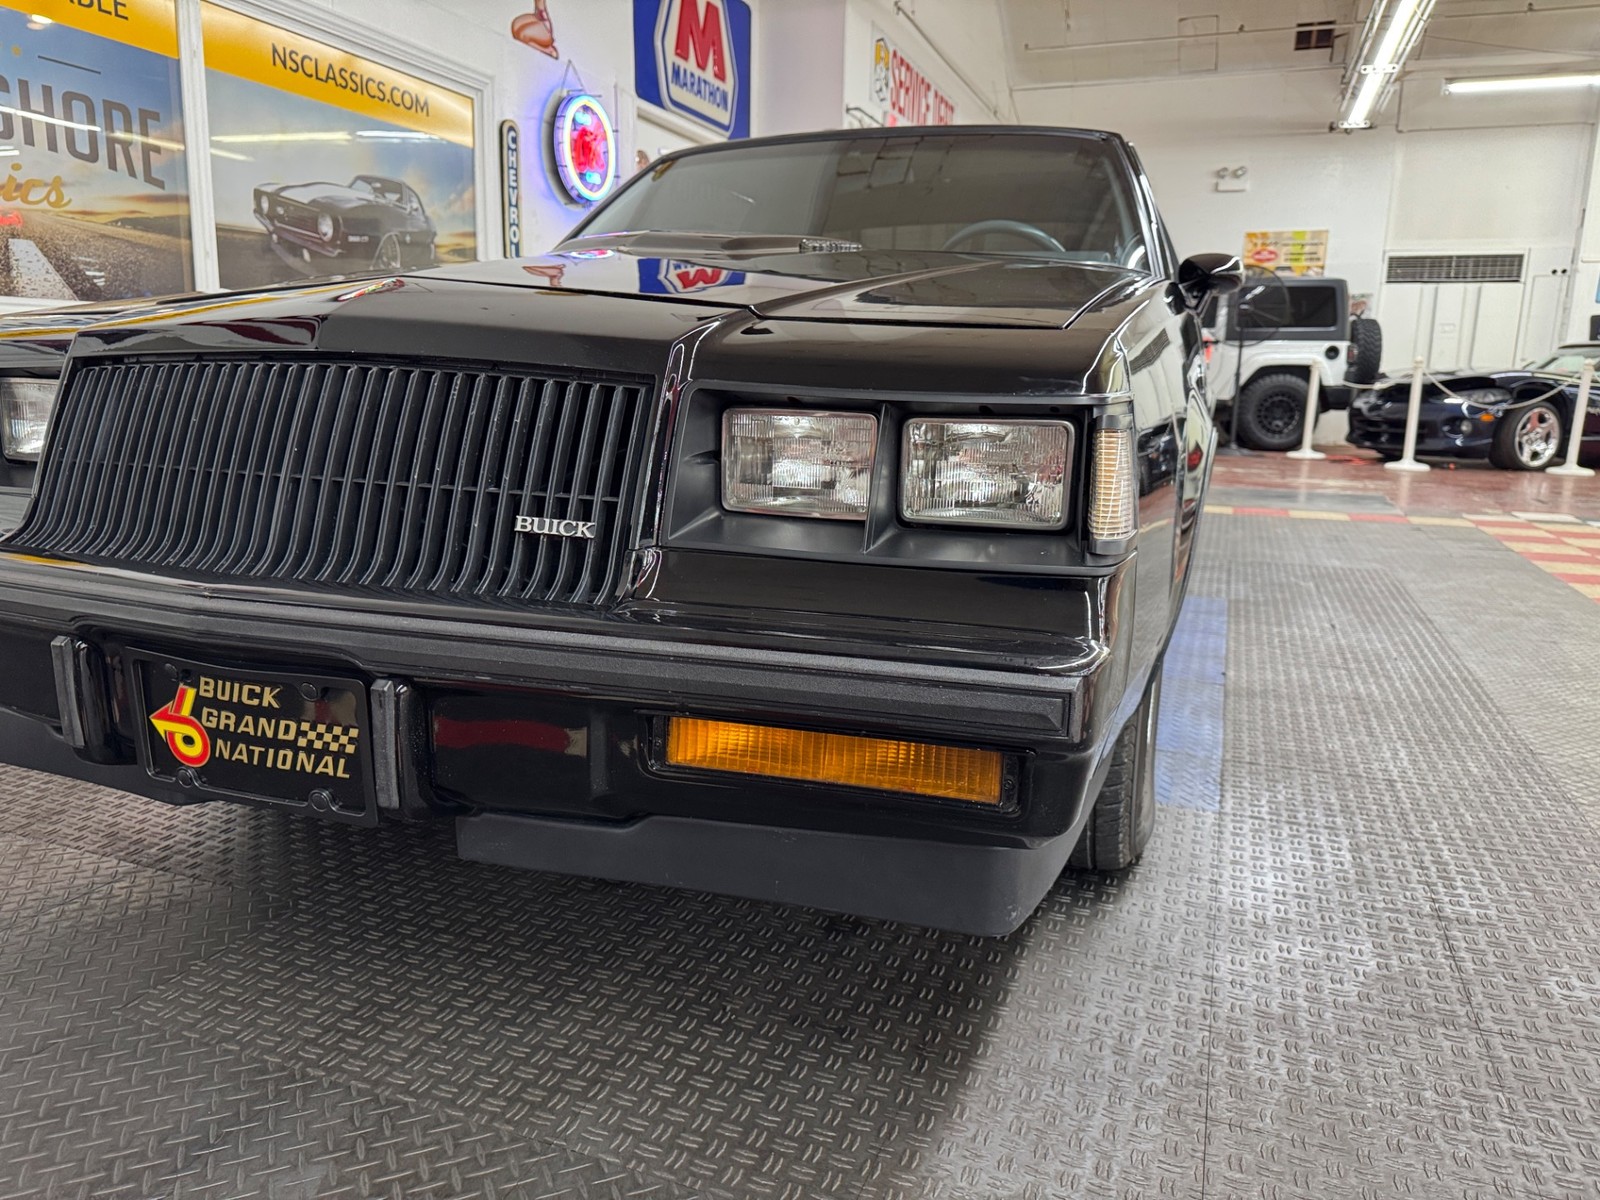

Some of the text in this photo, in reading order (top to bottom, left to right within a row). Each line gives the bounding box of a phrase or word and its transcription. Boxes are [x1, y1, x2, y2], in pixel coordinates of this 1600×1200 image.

[674, 0, 726, 83] M
[271, 42, 430, 117] NSCLASSICS.COM
[671, 61, 728, 112] MARATHON
[890, 49, 931, 126] SERVICE
[514, 515, 596, 539] BUICK
[199, 676, 283, 708] BUICK
[202, 706, 297, 741] GRAND
[215, 738, 350, 779] NATIONAL
